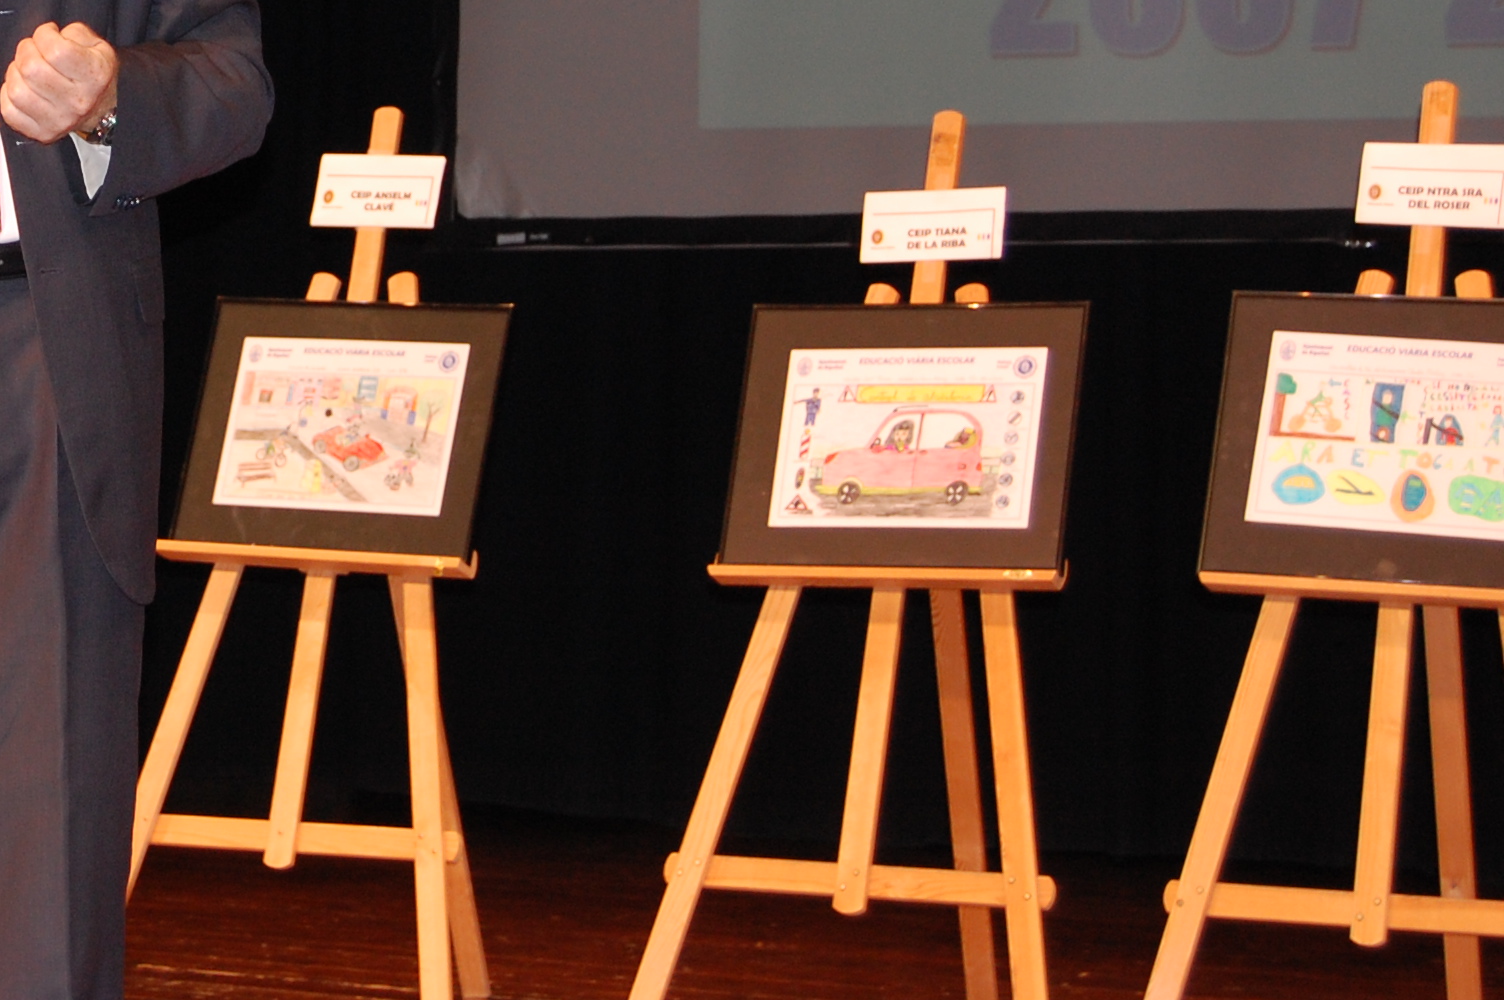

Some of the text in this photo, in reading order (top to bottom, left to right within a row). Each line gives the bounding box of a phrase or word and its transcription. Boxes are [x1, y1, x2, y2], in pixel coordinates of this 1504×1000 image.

[351, 191, 372, 199] CEIP
[1398, 186, 1424, 195] CEIP
[1427, 187, 1458, 196] NTRA
[1408, 200, 1470, 210] DEL ROSER
[908, 227, 967, 237] CEIP TIANA
[907, 239, 966, 249] DE LA RIBA
